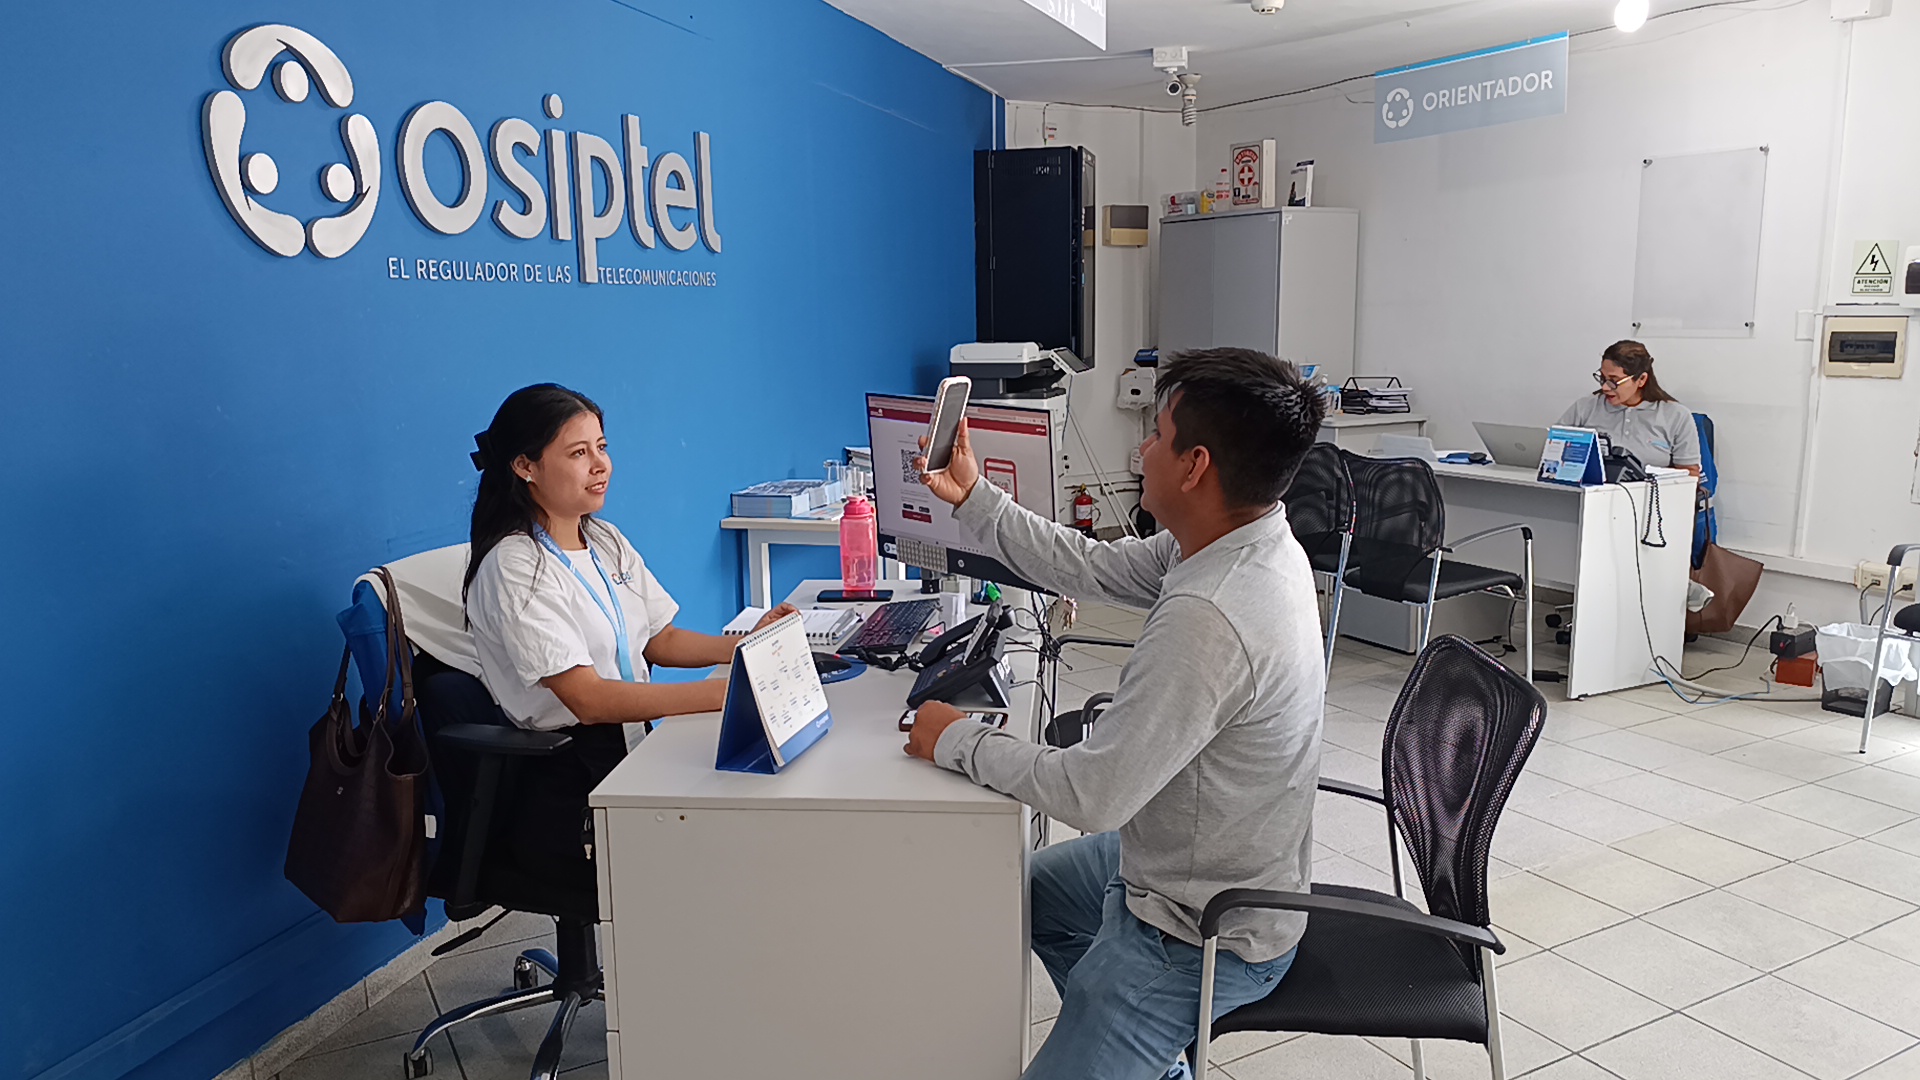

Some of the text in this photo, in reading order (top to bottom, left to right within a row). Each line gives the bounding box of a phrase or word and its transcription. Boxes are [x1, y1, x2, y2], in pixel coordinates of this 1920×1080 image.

[1422, 70, 1554, 111] ORIENTADOR
[398, 93, 722, 284] osiptel
[388, 257, 717, 287] EL REGULADOR DE LAS TELECOMUNICACIONES
